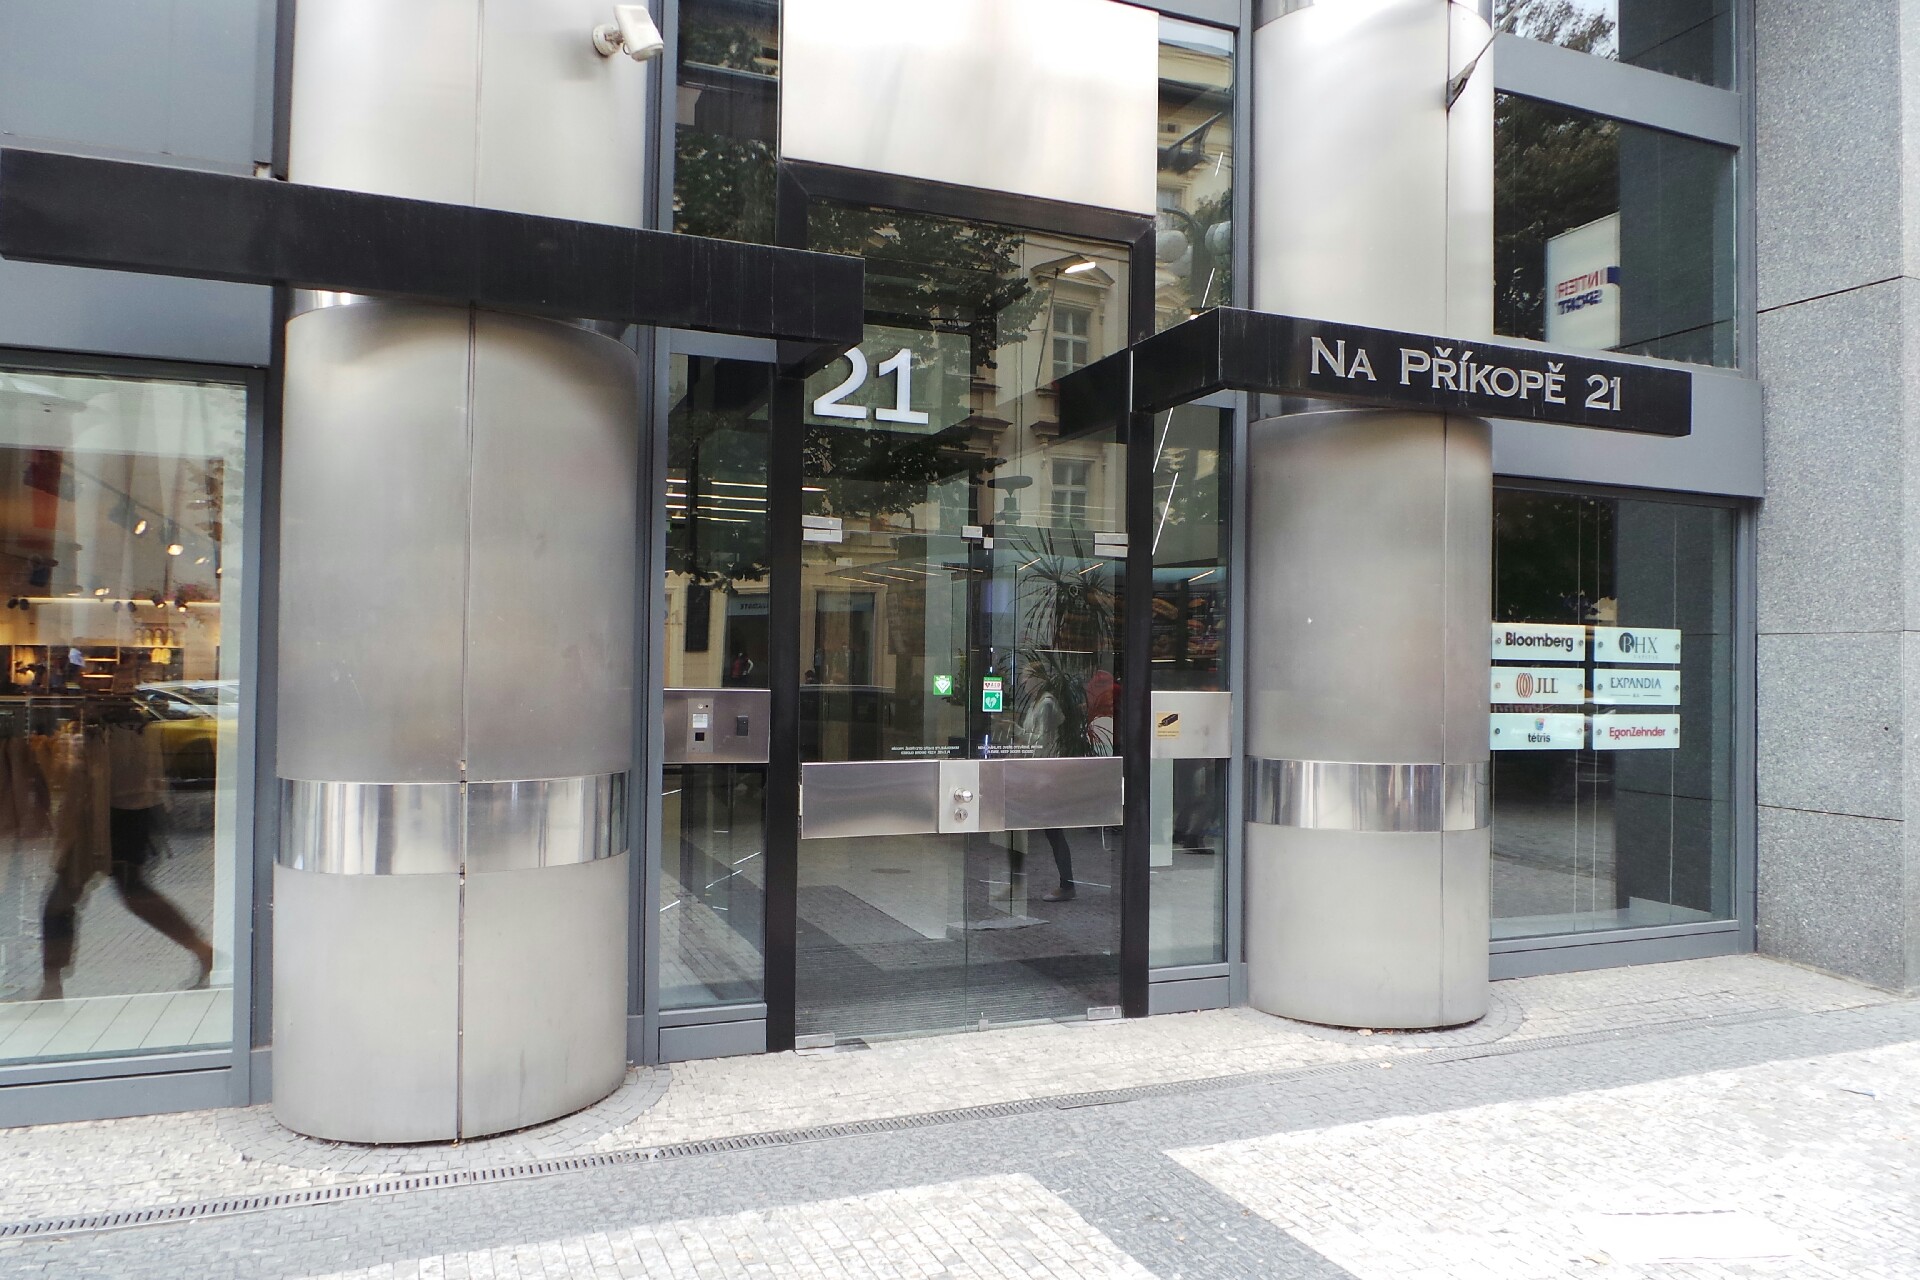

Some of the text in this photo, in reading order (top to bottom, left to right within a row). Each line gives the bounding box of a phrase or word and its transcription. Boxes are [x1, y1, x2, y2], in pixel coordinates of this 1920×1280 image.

[1310, 336, 1621, 411] NA PŘÍKOPĚ 21
[814, 347, 929, 425] 21
[1505, 632, 1574, 652] Bloomberg
[1535, 677, 1559, 694] JLL
[1610, 677, 1662, 689] EXPANDIA
[1527, 732, 1551, 743] tétris
[1609, 726, 1666, 740] EgonZehnder
